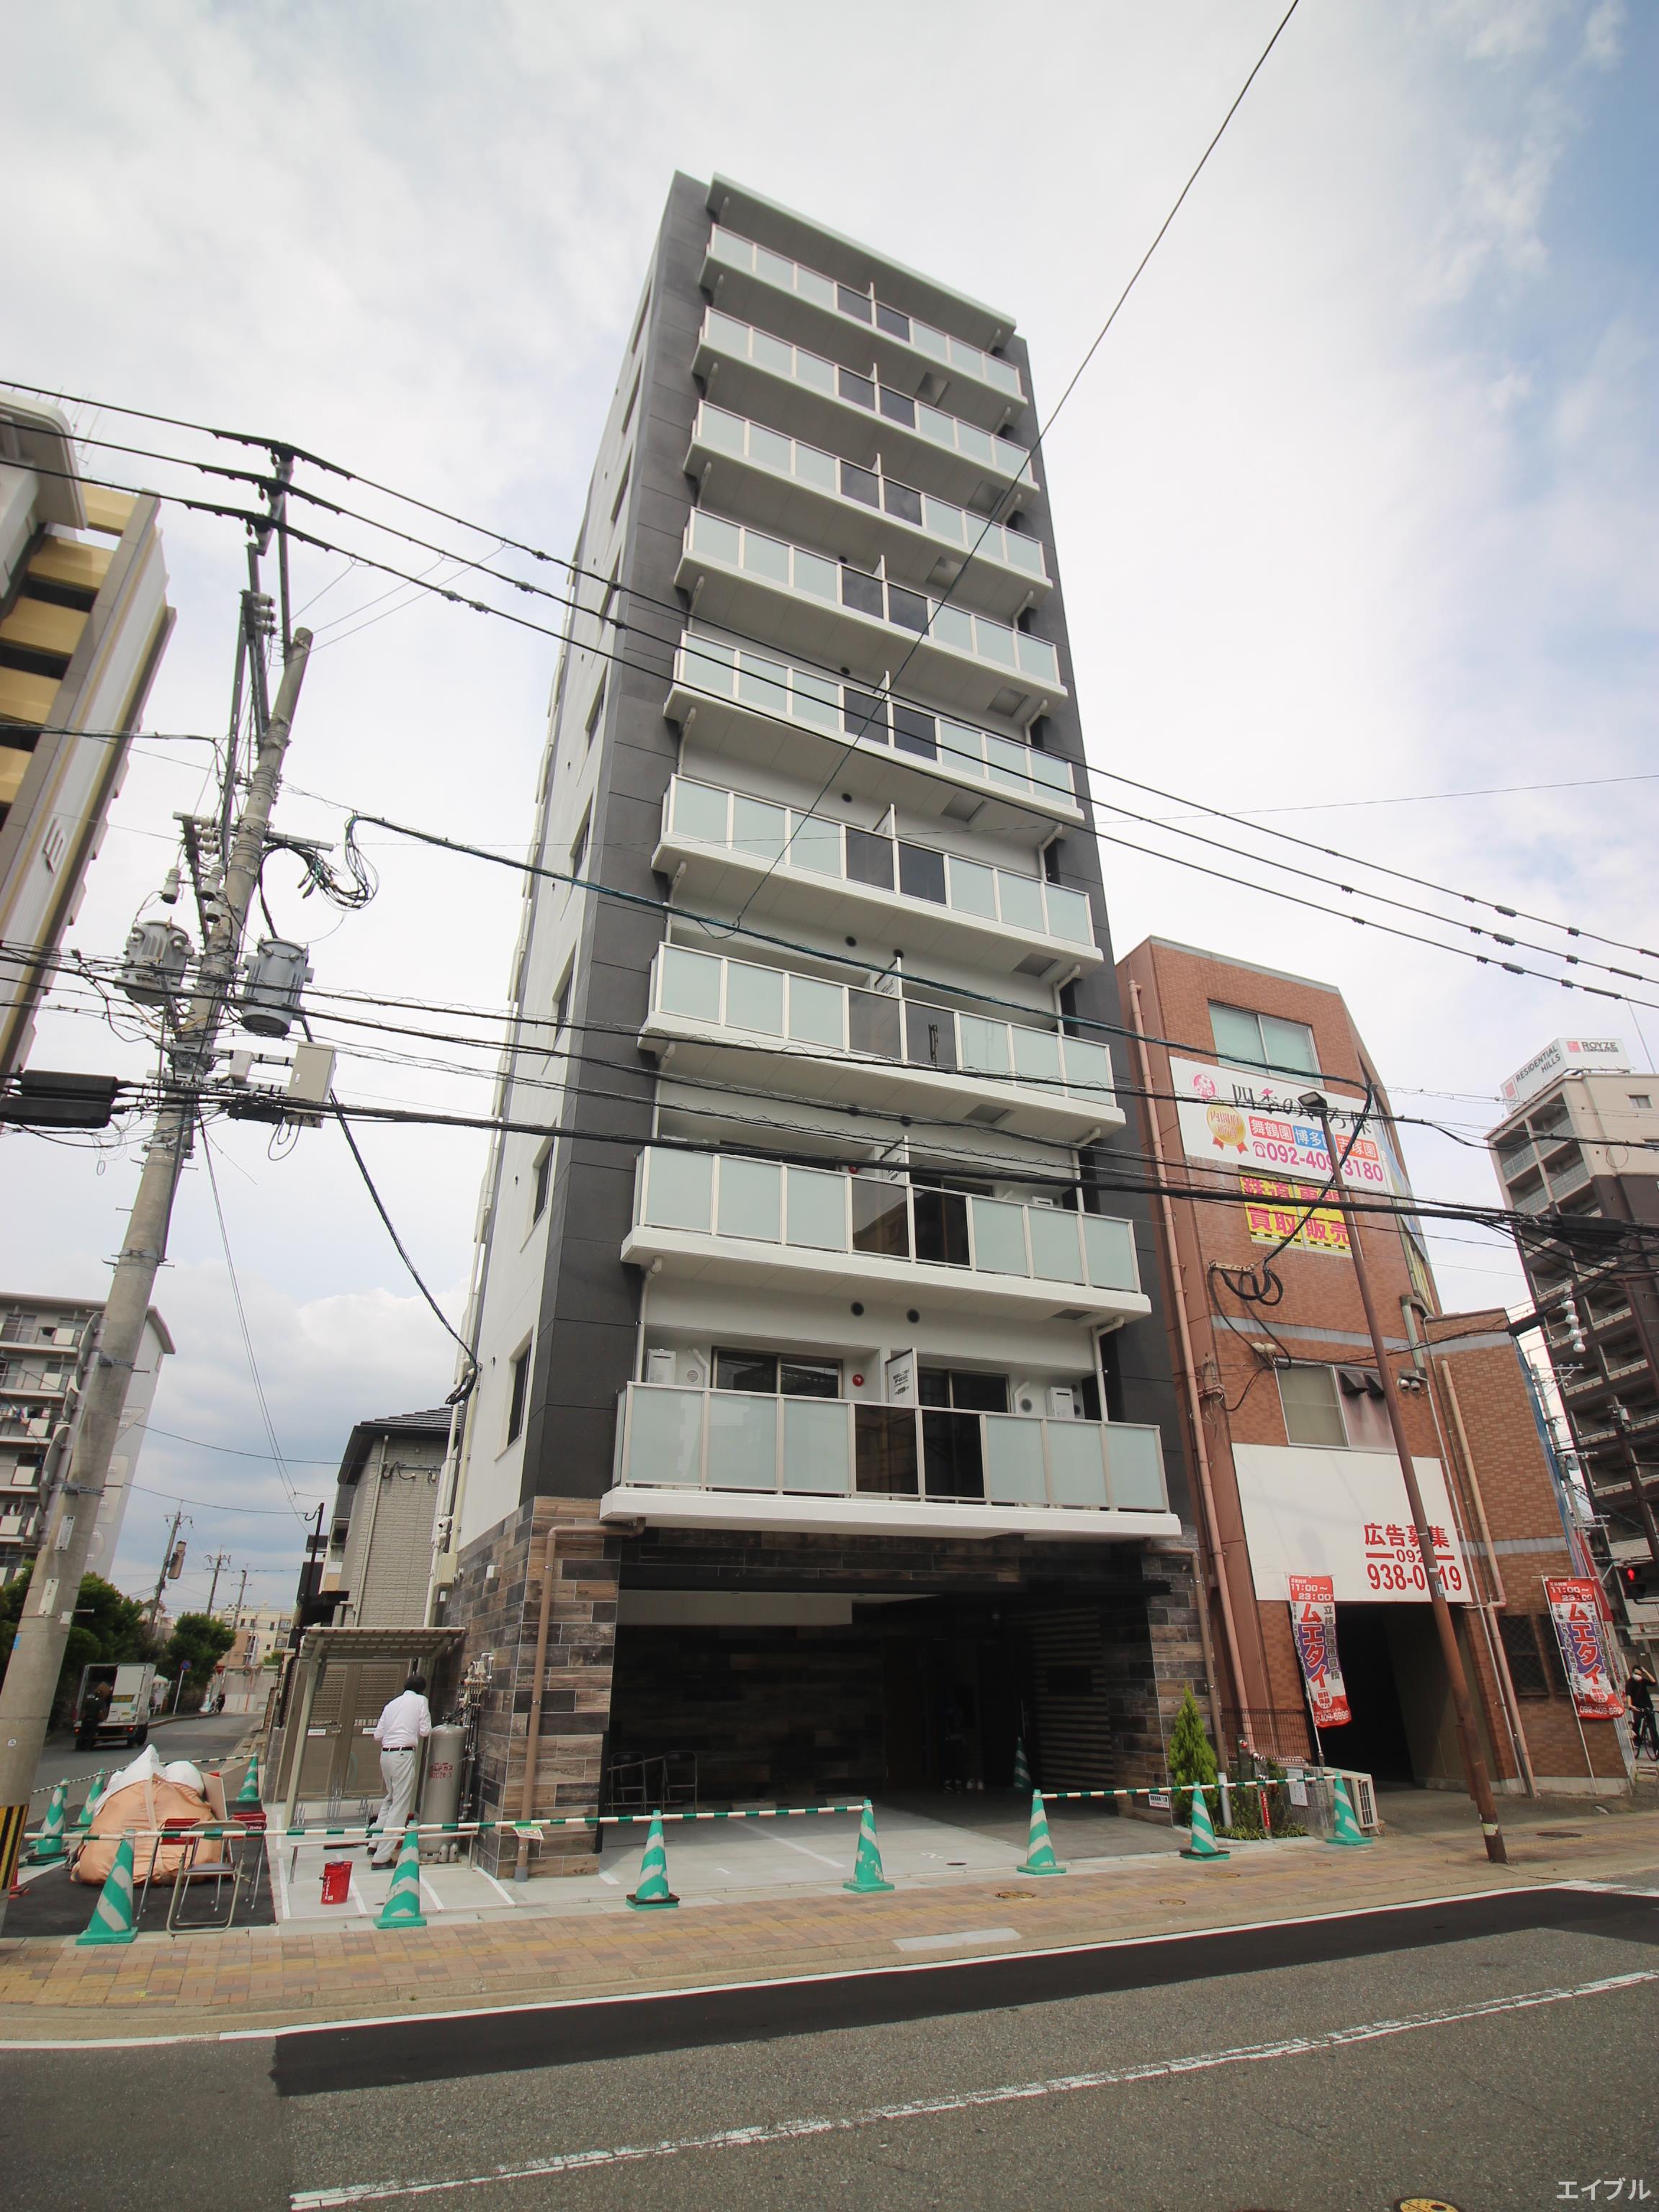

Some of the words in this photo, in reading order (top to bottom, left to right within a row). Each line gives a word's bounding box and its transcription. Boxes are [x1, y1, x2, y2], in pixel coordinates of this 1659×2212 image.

[1515, 1046, 1558, 1082] RESIDENTIAL
[1541, 1053, 1561, 1074] HILLS
[1250, 1119, 1293, 1141] 舞鶴園
[1367, 1563, 1462, 1591] 938-019
[1300, 1602, 1327, 1688] ムエタイ
[1568, 1604, 1601, 1685] ムエタイ
